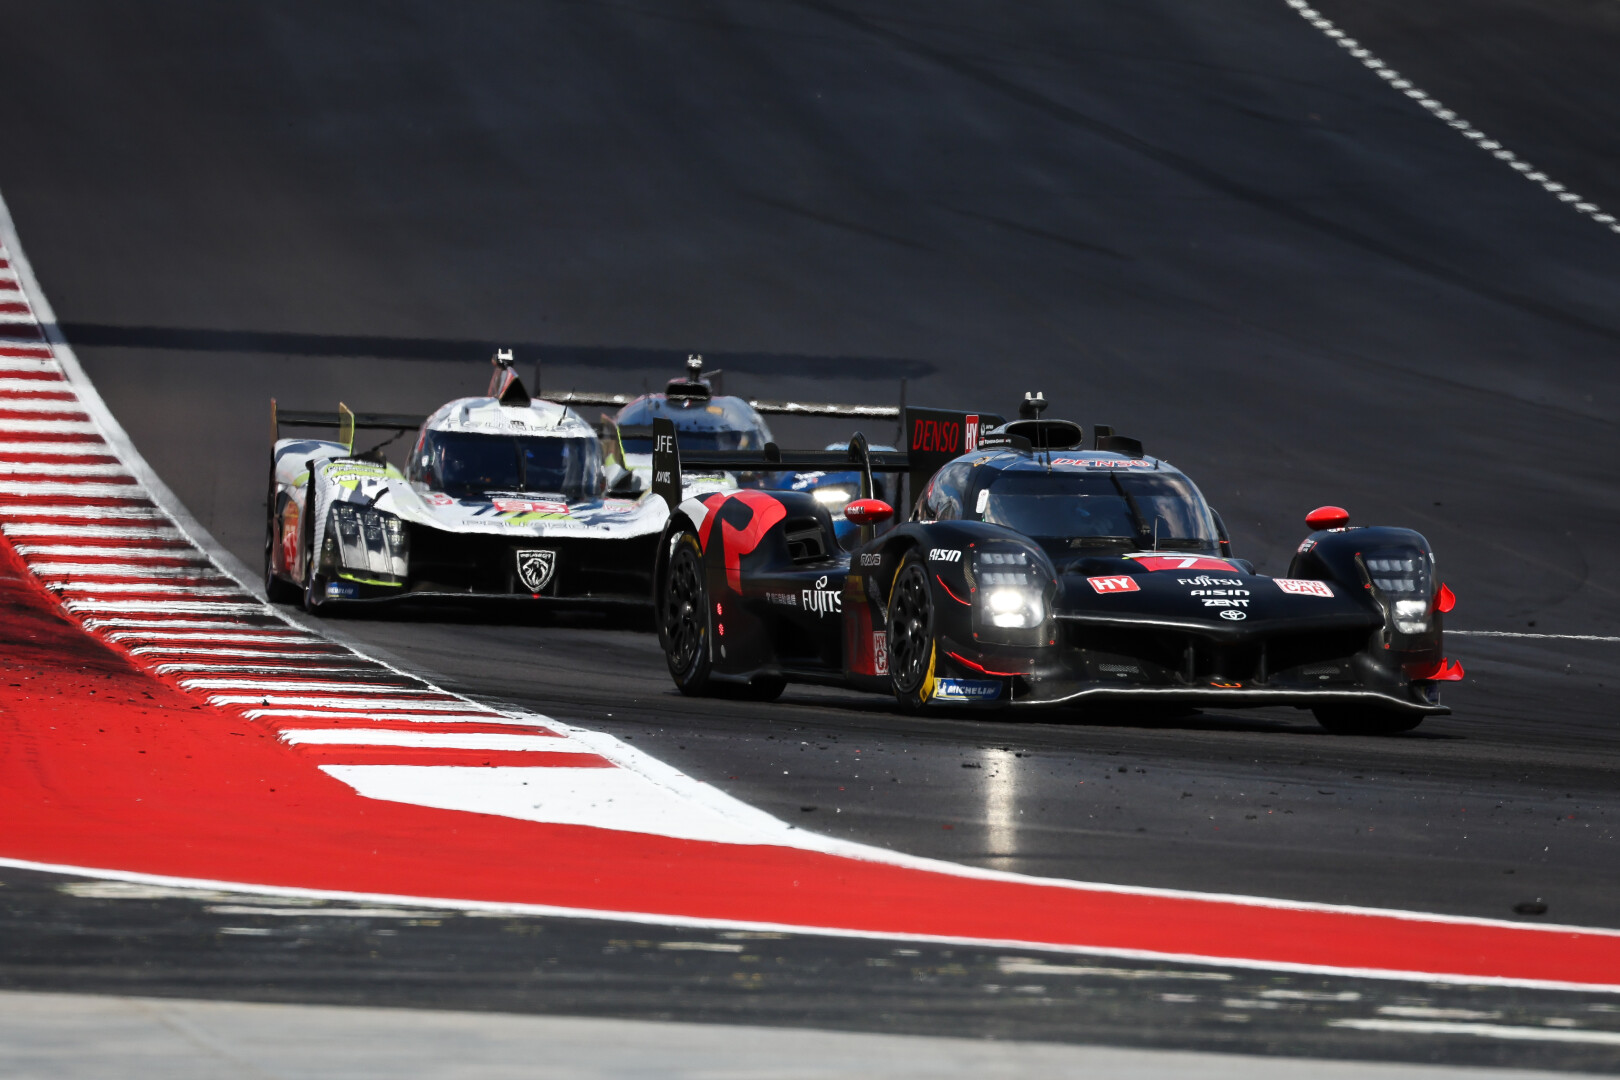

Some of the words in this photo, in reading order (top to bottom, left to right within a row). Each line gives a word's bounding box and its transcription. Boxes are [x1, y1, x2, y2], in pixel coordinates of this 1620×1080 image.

[912, 419, 960, 453] DENSO
[966, 423, 978, 450] HY
[654, 434, 673, 453] JFE
[1051, 458, 1150, 468] DENSO
[929, 548, 962, 563] AISIN
[1162, 556, 1199, 568] 7
[1092, 577, 1129, 590] HY
[1177, 577, 1243, 587] FUJITSU
[1284, 584, 1328, 595] CAR
[802, 589, 842, 619] FUJITS
[1202, 598, 1250, 607] ZENT
[947, 685, 996, 695] MICHELIN
